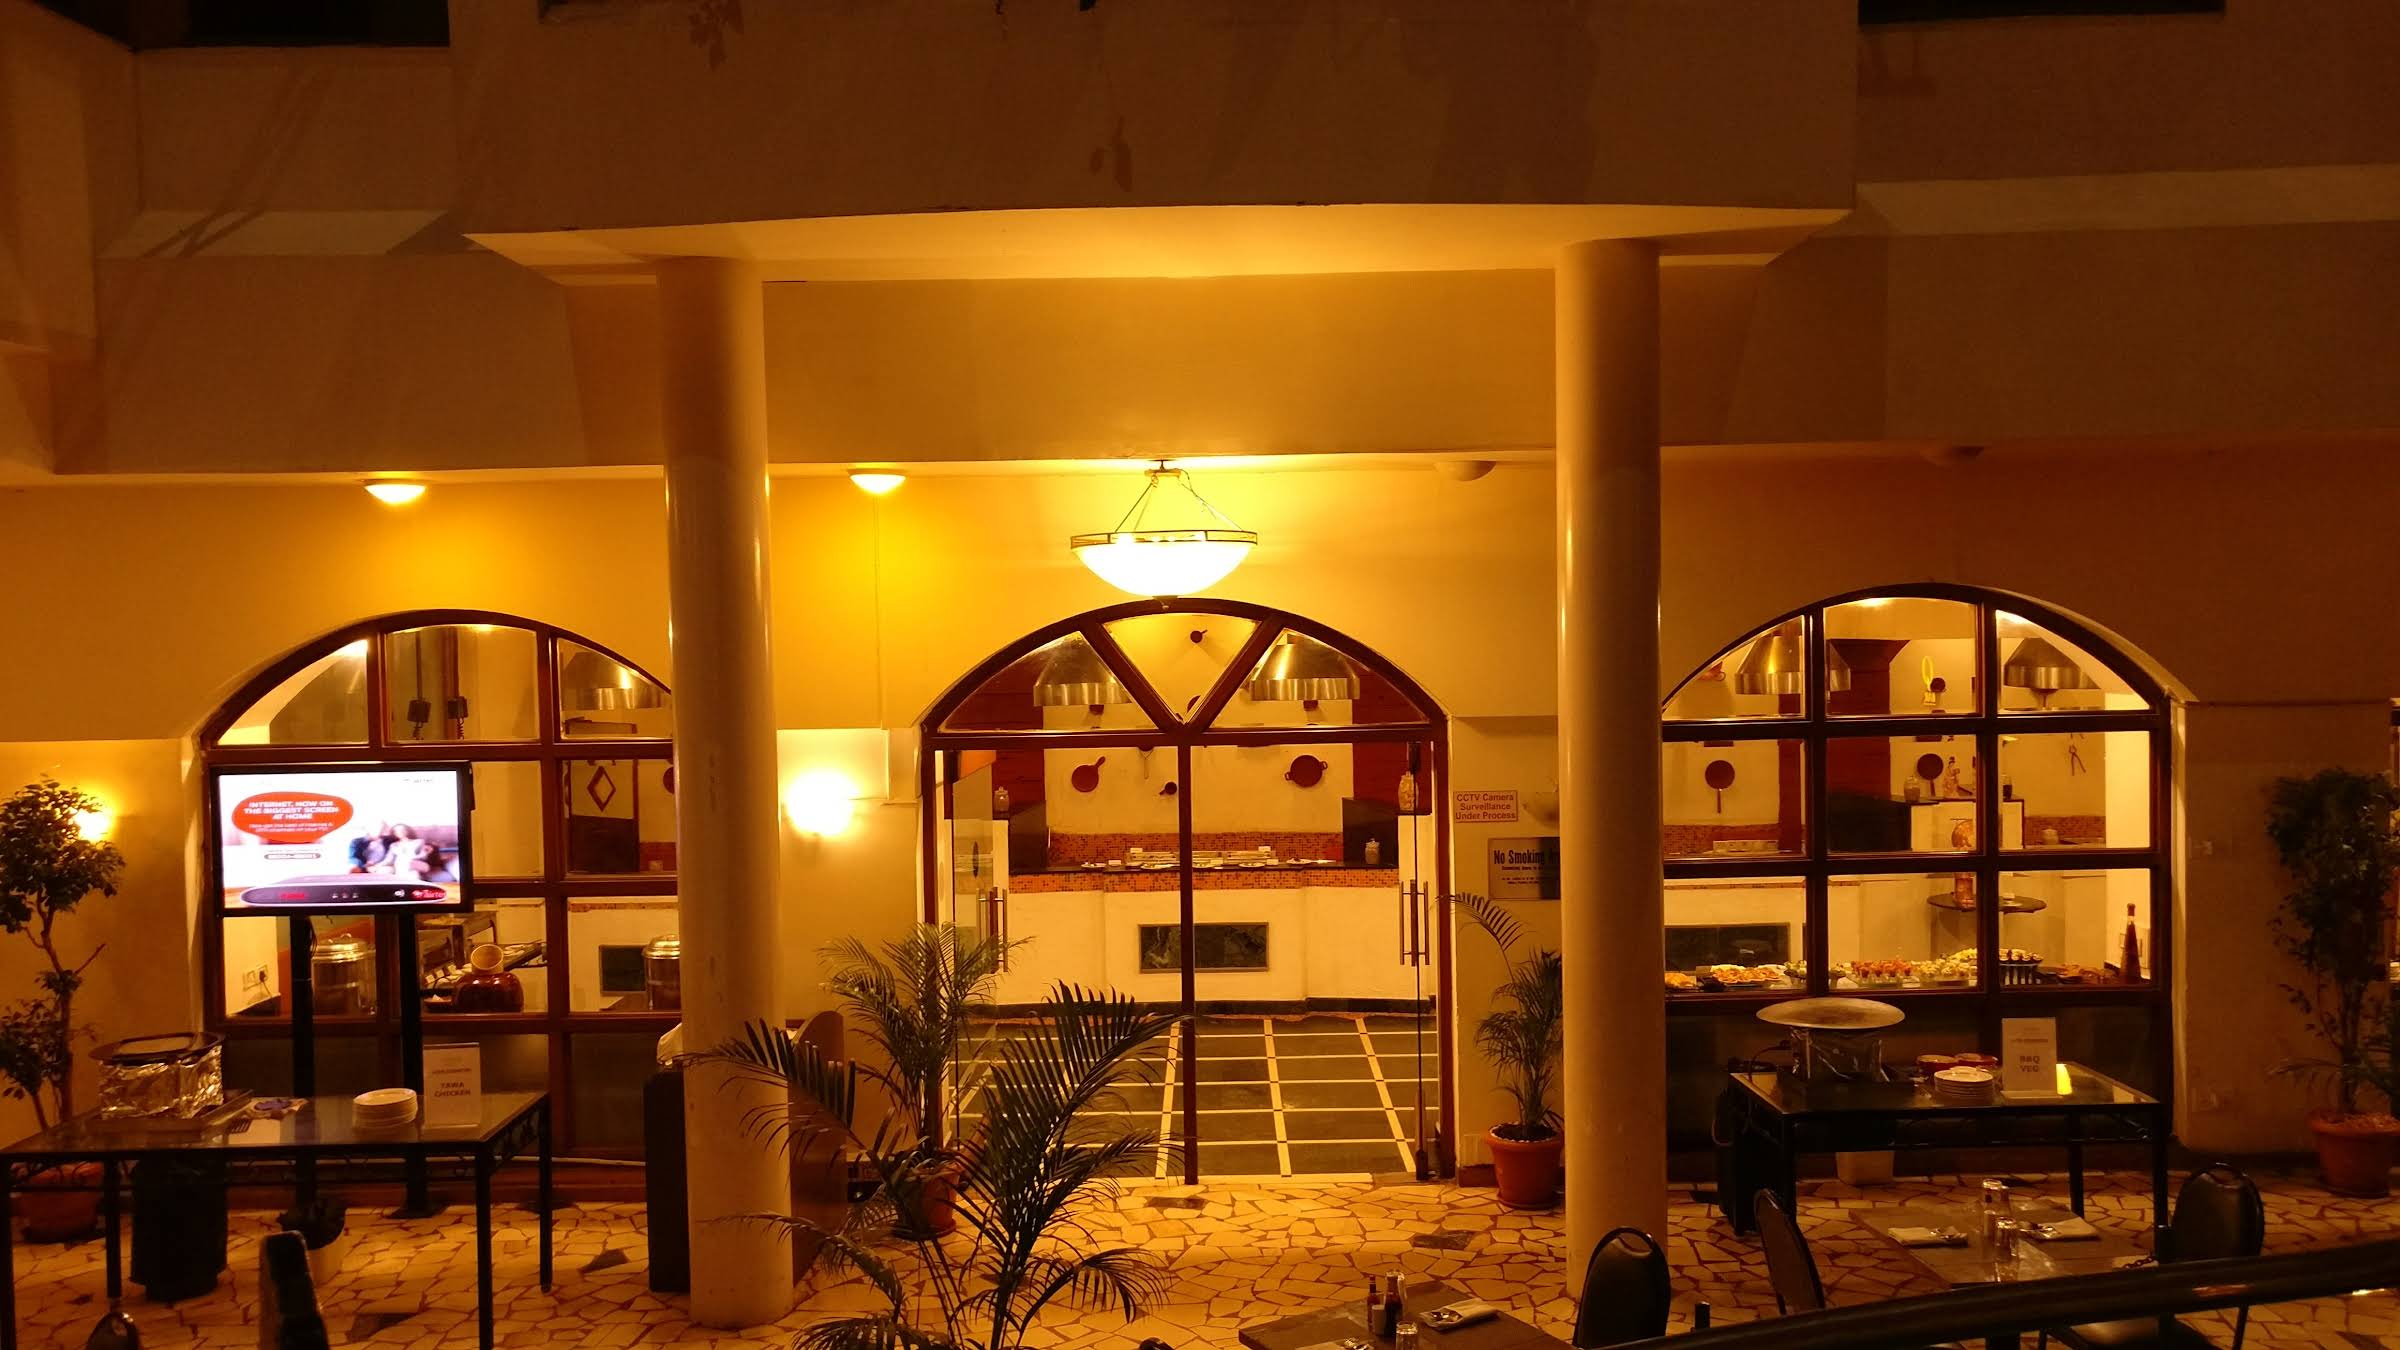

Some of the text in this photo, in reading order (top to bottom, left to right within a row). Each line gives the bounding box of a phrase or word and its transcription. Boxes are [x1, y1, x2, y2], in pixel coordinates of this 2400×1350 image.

[1456, 793, 1514, 802] CCTV Camera
[1460, 802, 1511, 811] Surveillance
[1455, 811, 1516, 820] Under Process
[1493, 850, 1505, 865] No
[1508, 849, 1545, 866] Smoking
